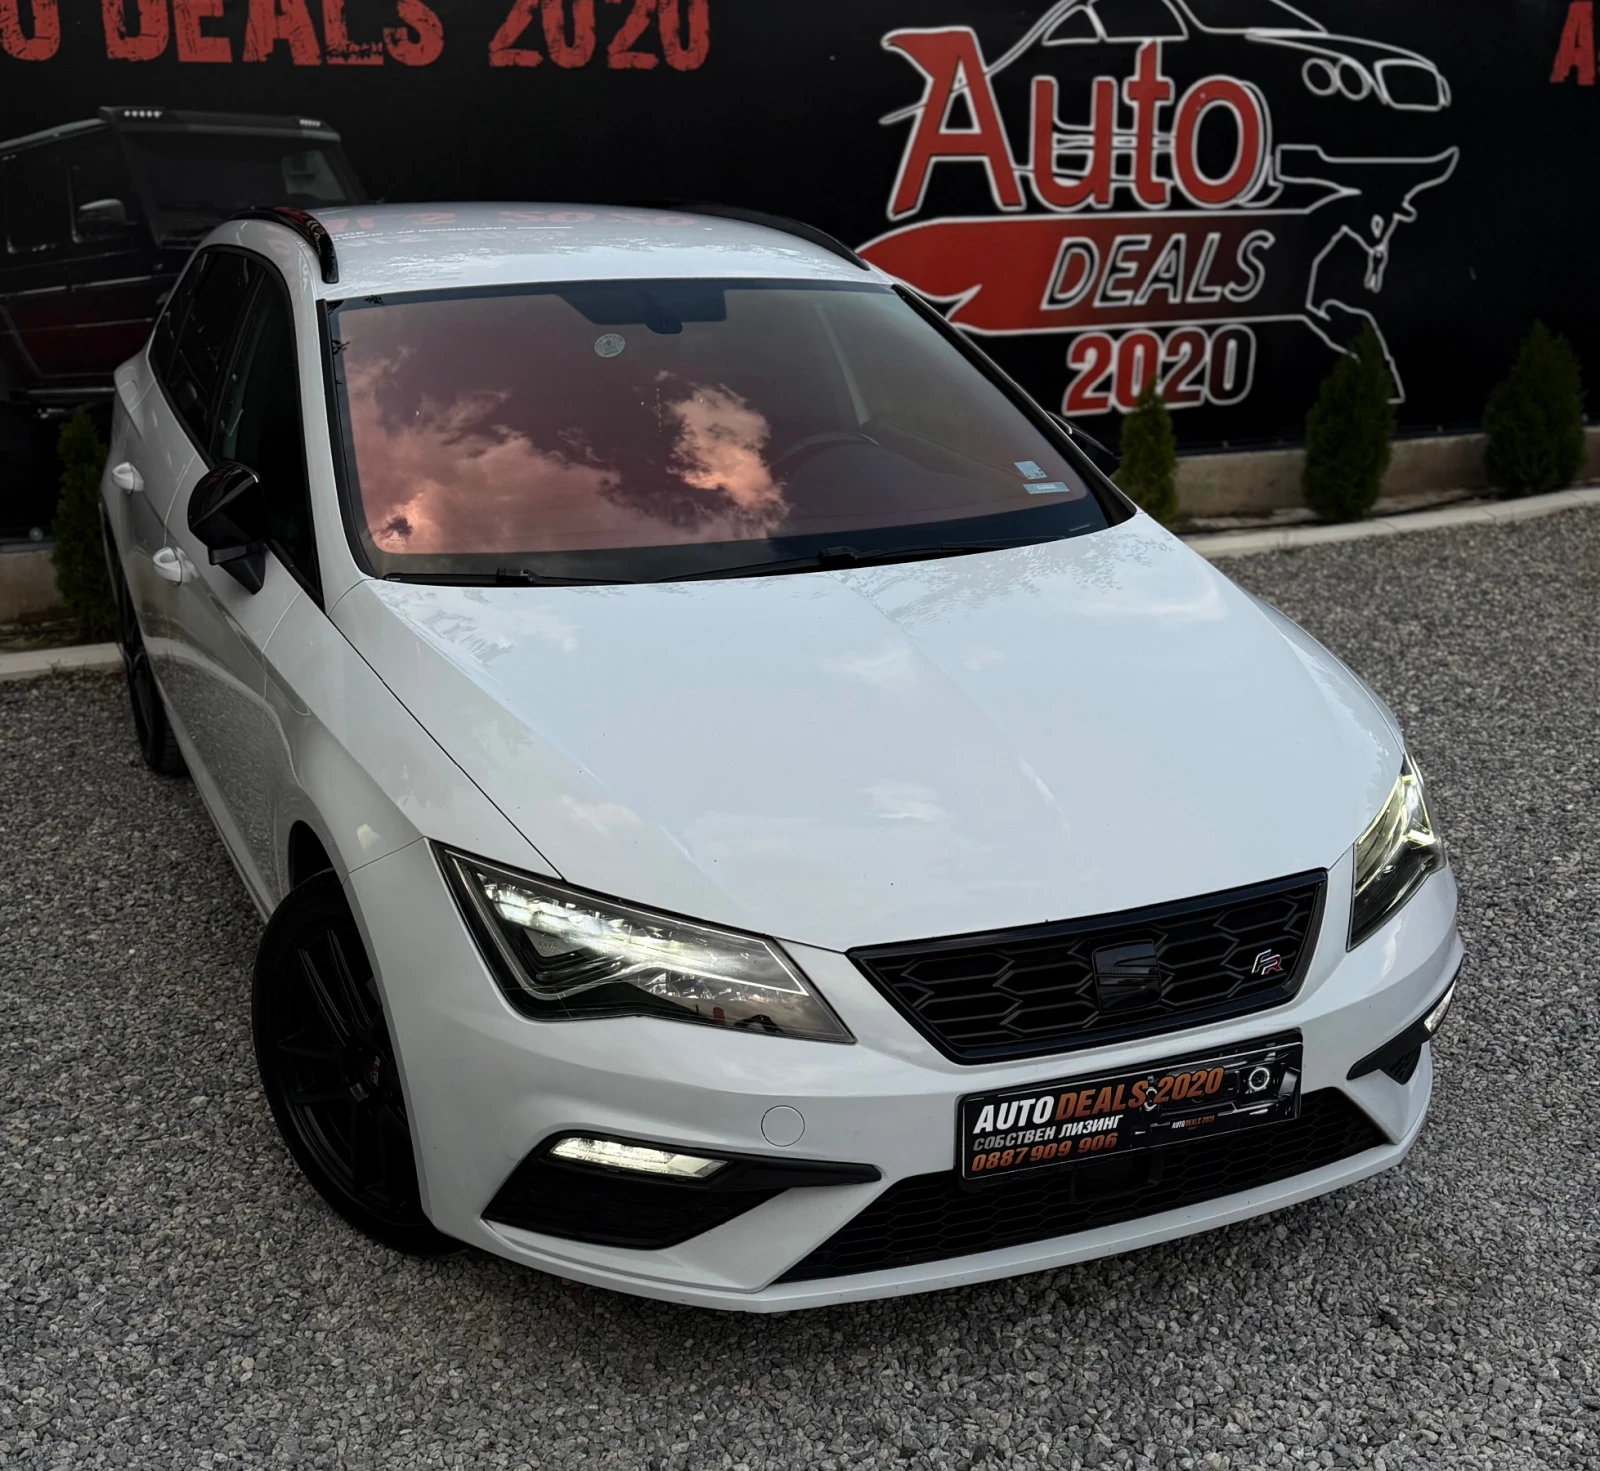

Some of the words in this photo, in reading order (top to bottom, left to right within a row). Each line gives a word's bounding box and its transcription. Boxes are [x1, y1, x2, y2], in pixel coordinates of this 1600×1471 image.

[488, 0, 710, 71] 2020
[880, 26, 1264, 220] Auto
[1040, 230, 1275, 311] DEALS
[1061, 323, 1257, 417] 2020
[972, 1095, 1055, 1134] AUTO
[1152, 1066, 1225, 1104] 2020
[973, 1126, 1057, 1151] СОБСТВЕН
[1058, 1115, 1124, 1138] ЛИЗИНГ
[1077, 1132, 1119, 1153] 906
